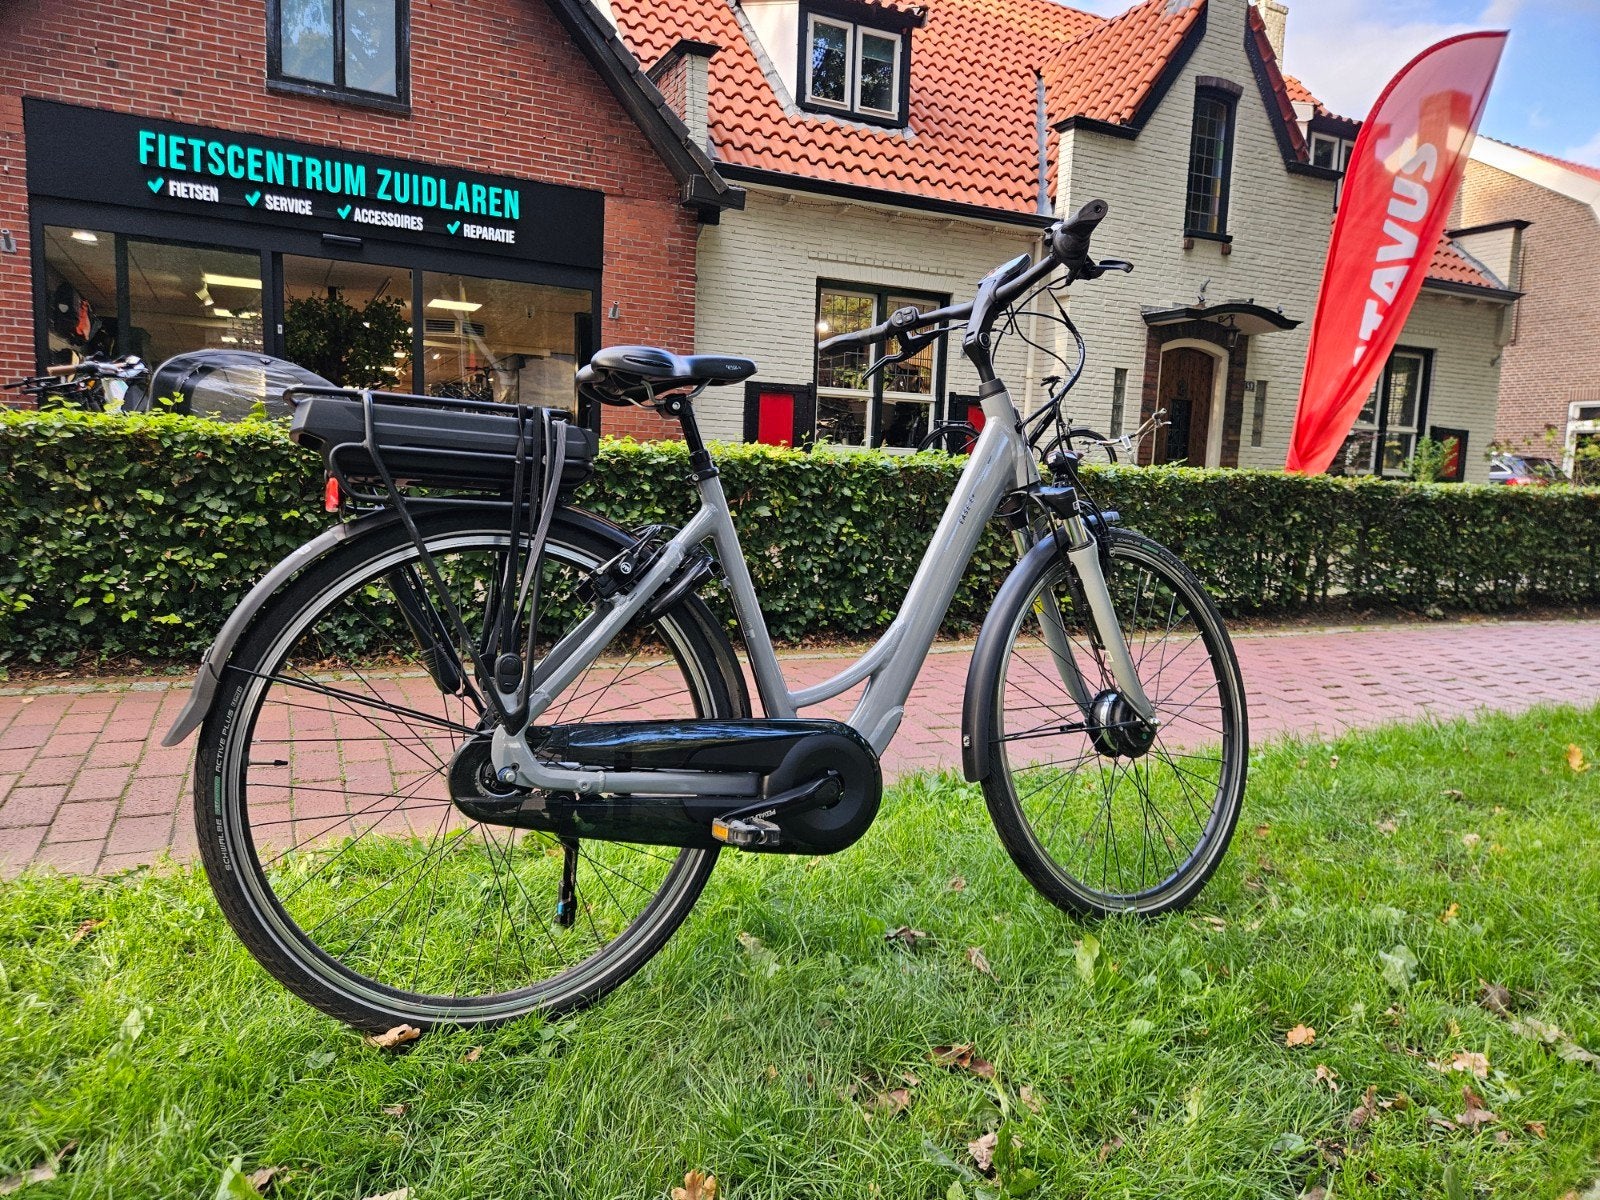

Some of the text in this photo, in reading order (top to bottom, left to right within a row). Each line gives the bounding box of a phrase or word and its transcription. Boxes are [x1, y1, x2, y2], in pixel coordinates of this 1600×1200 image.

[138, 130, 521, 220] FIETSCENTRUM ZUIDLAREN
[168, 179, 516, 244] FIETSEN SERVICE ACCESSOIRES REPARATIE
[1353, 138, 1438, 367] TAVUS
[215, 737, 226, 773] ACTIVE
[222, 709, 234, 736] PLUS
[215, 818, 232, 871] SCHWALBE
